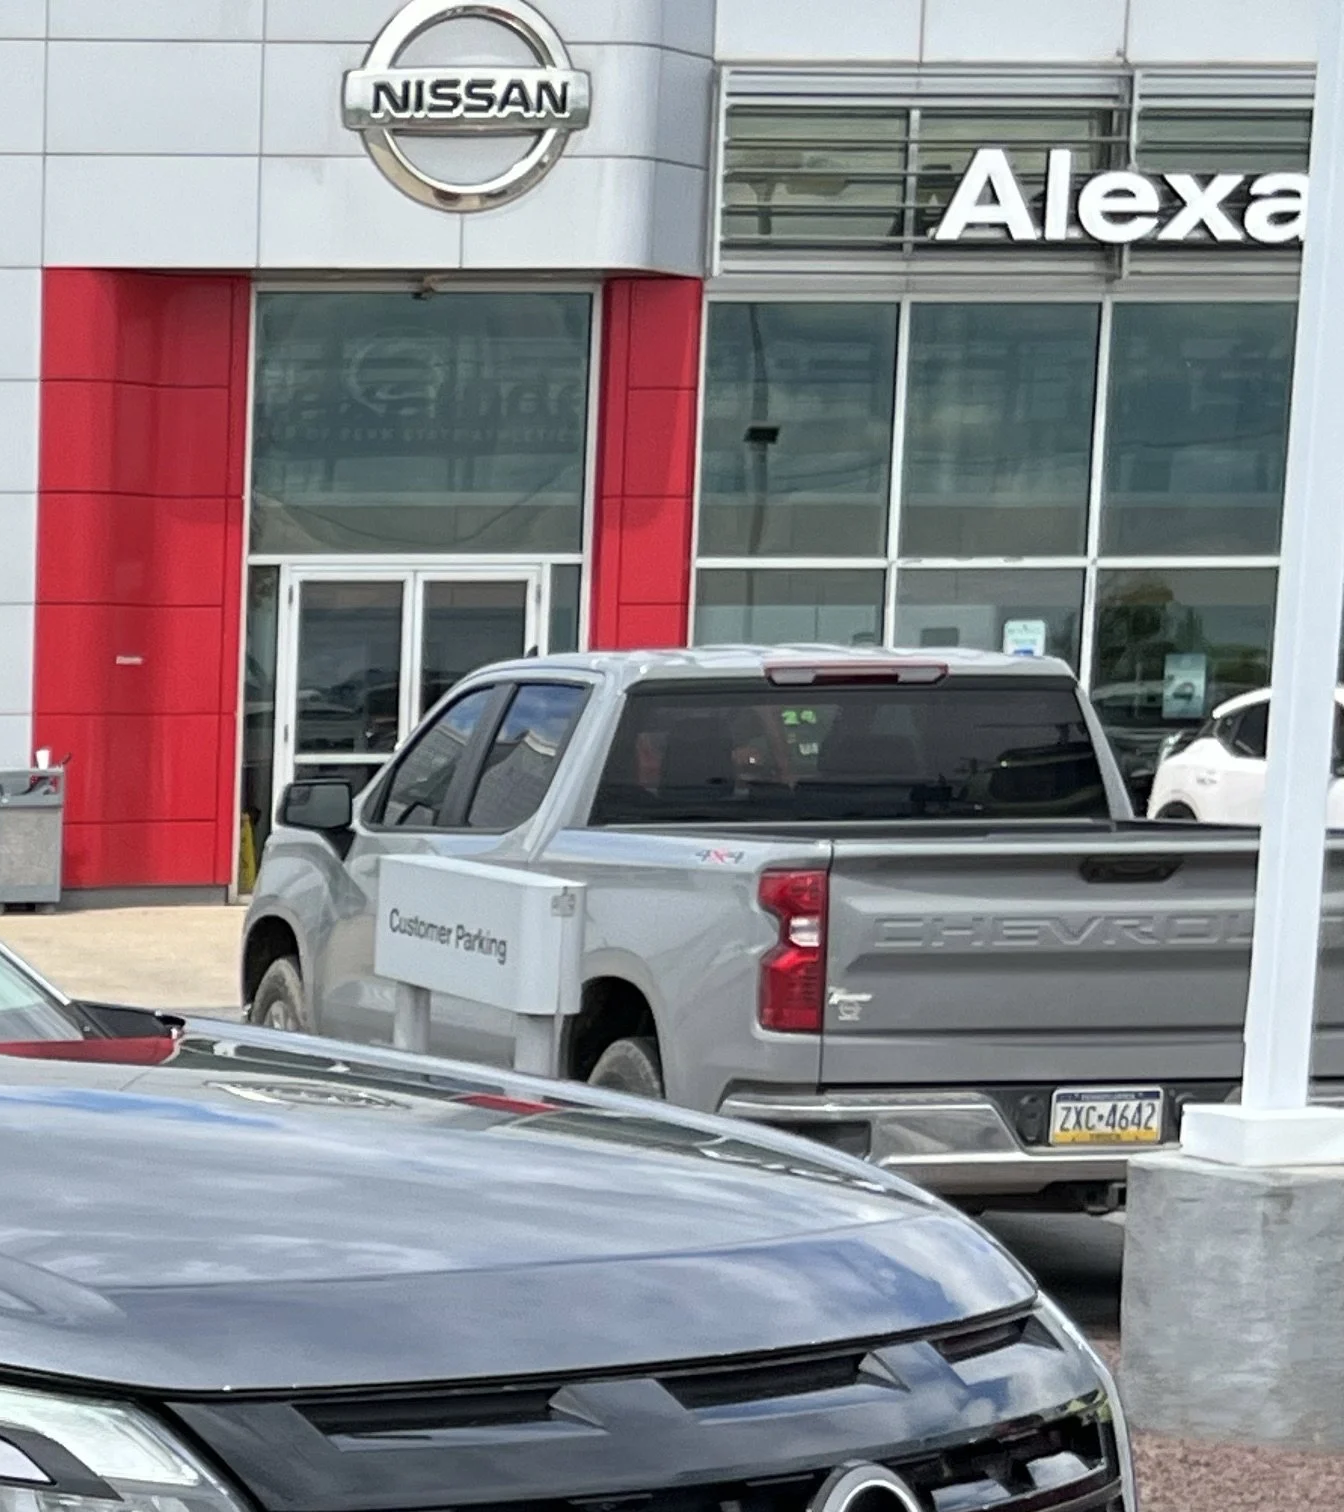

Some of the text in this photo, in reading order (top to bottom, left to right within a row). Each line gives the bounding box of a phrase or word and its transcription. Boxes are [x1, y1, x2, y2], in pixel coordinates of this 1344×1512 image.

[371, 78, 569, 114] NISSAN
[389, 908, 508, 965] Customer Parking
